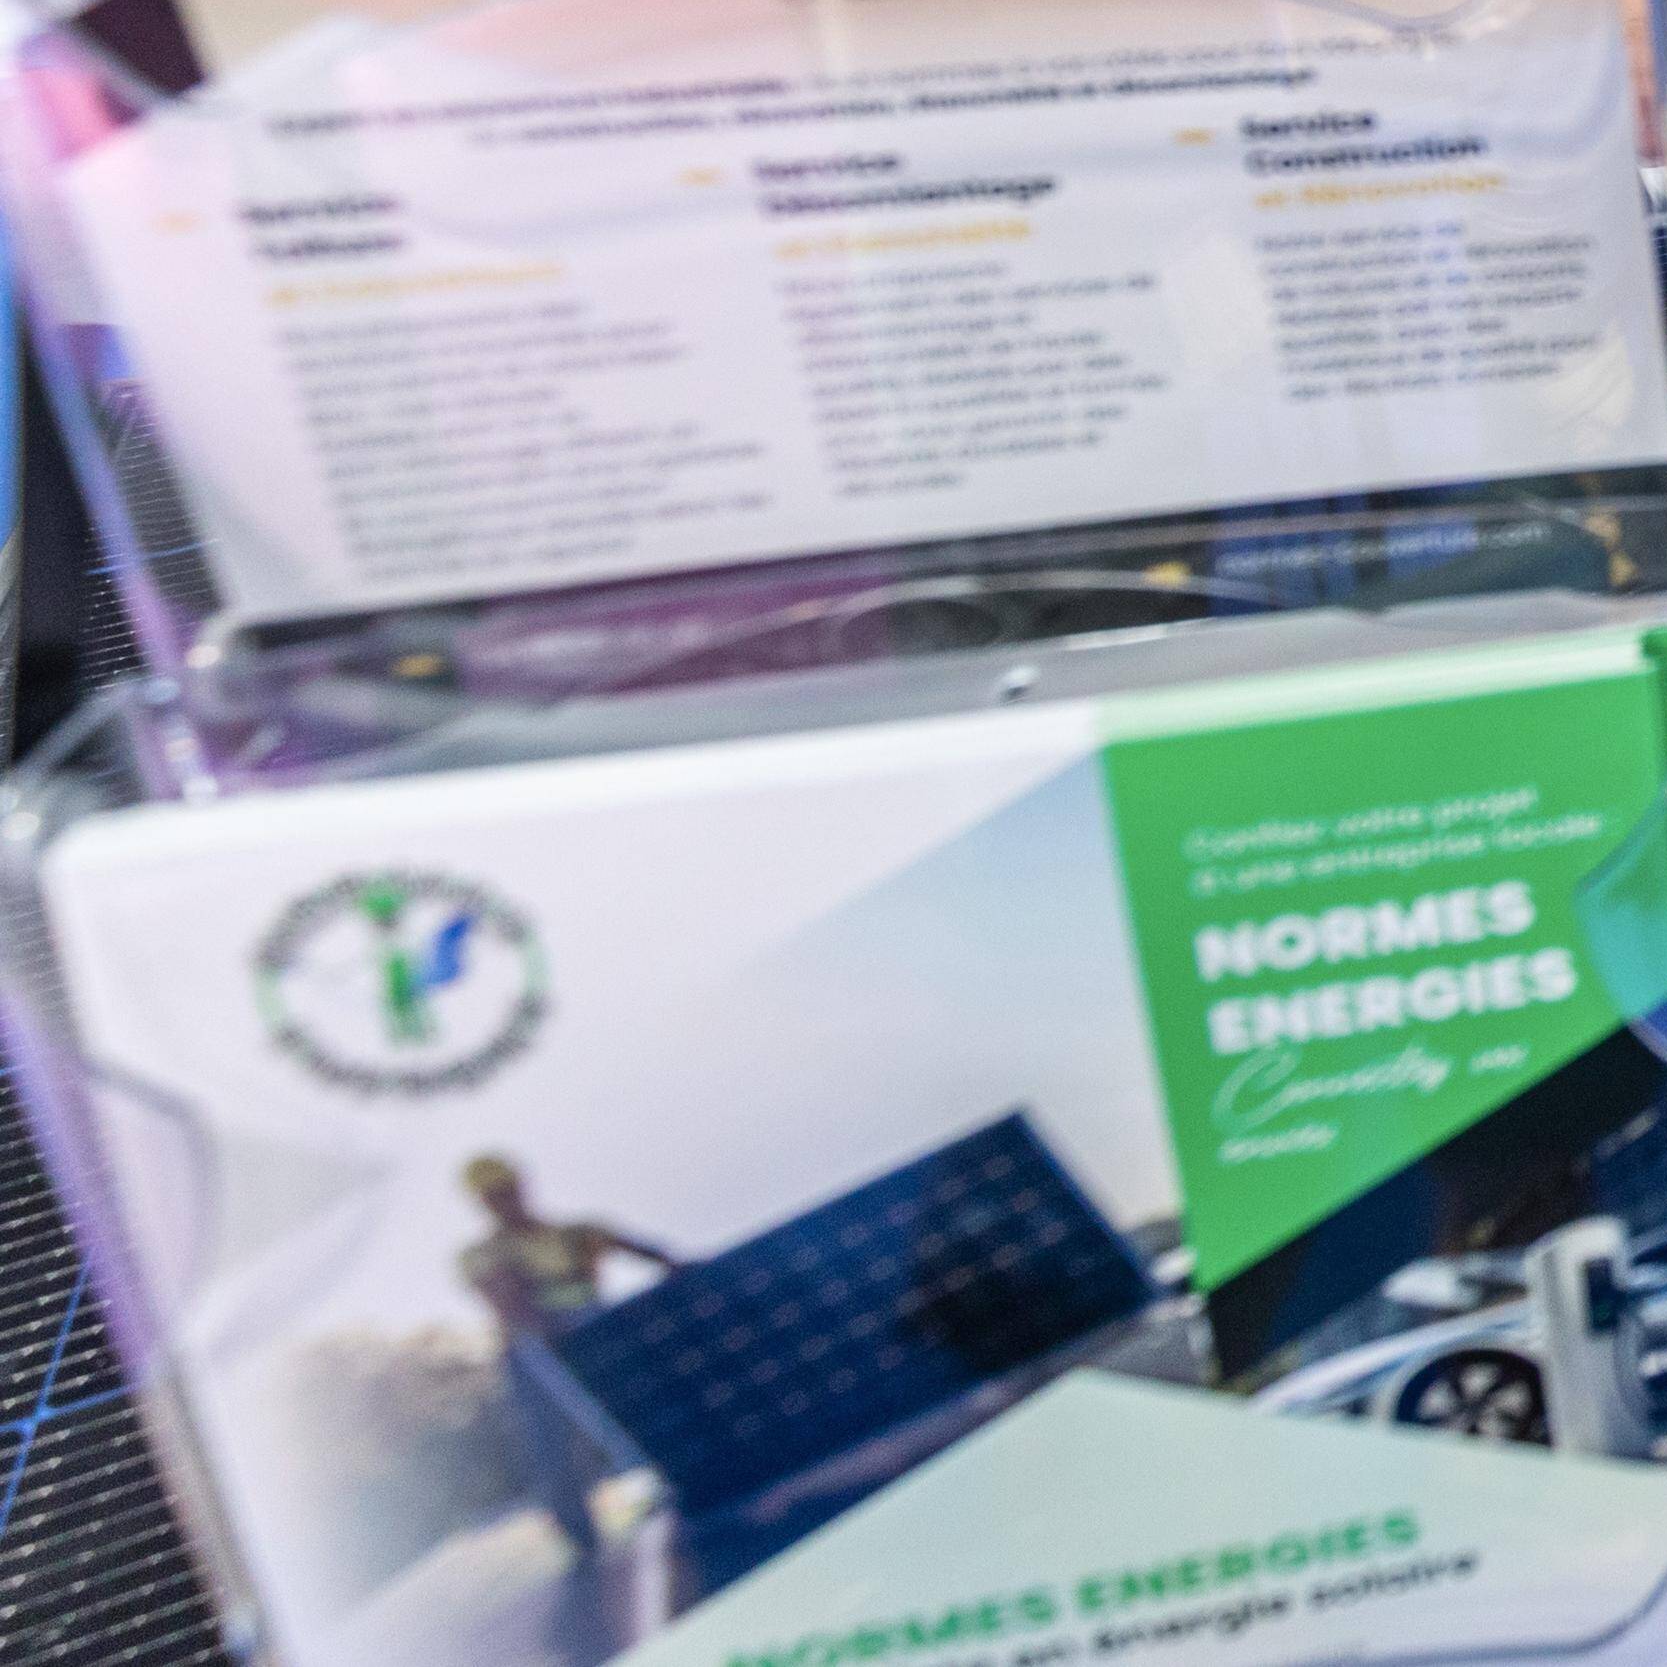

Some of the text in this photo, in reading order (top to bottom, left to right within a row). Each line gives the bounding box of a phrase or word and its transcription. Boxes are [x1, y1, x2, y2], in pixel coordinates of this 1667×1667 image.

[1192, 881, 1537, 984] NORMES
[1205, 946, 1580, 1058] ENERGIES
[1076, 1506, 1423, 1616] ENERGIES
